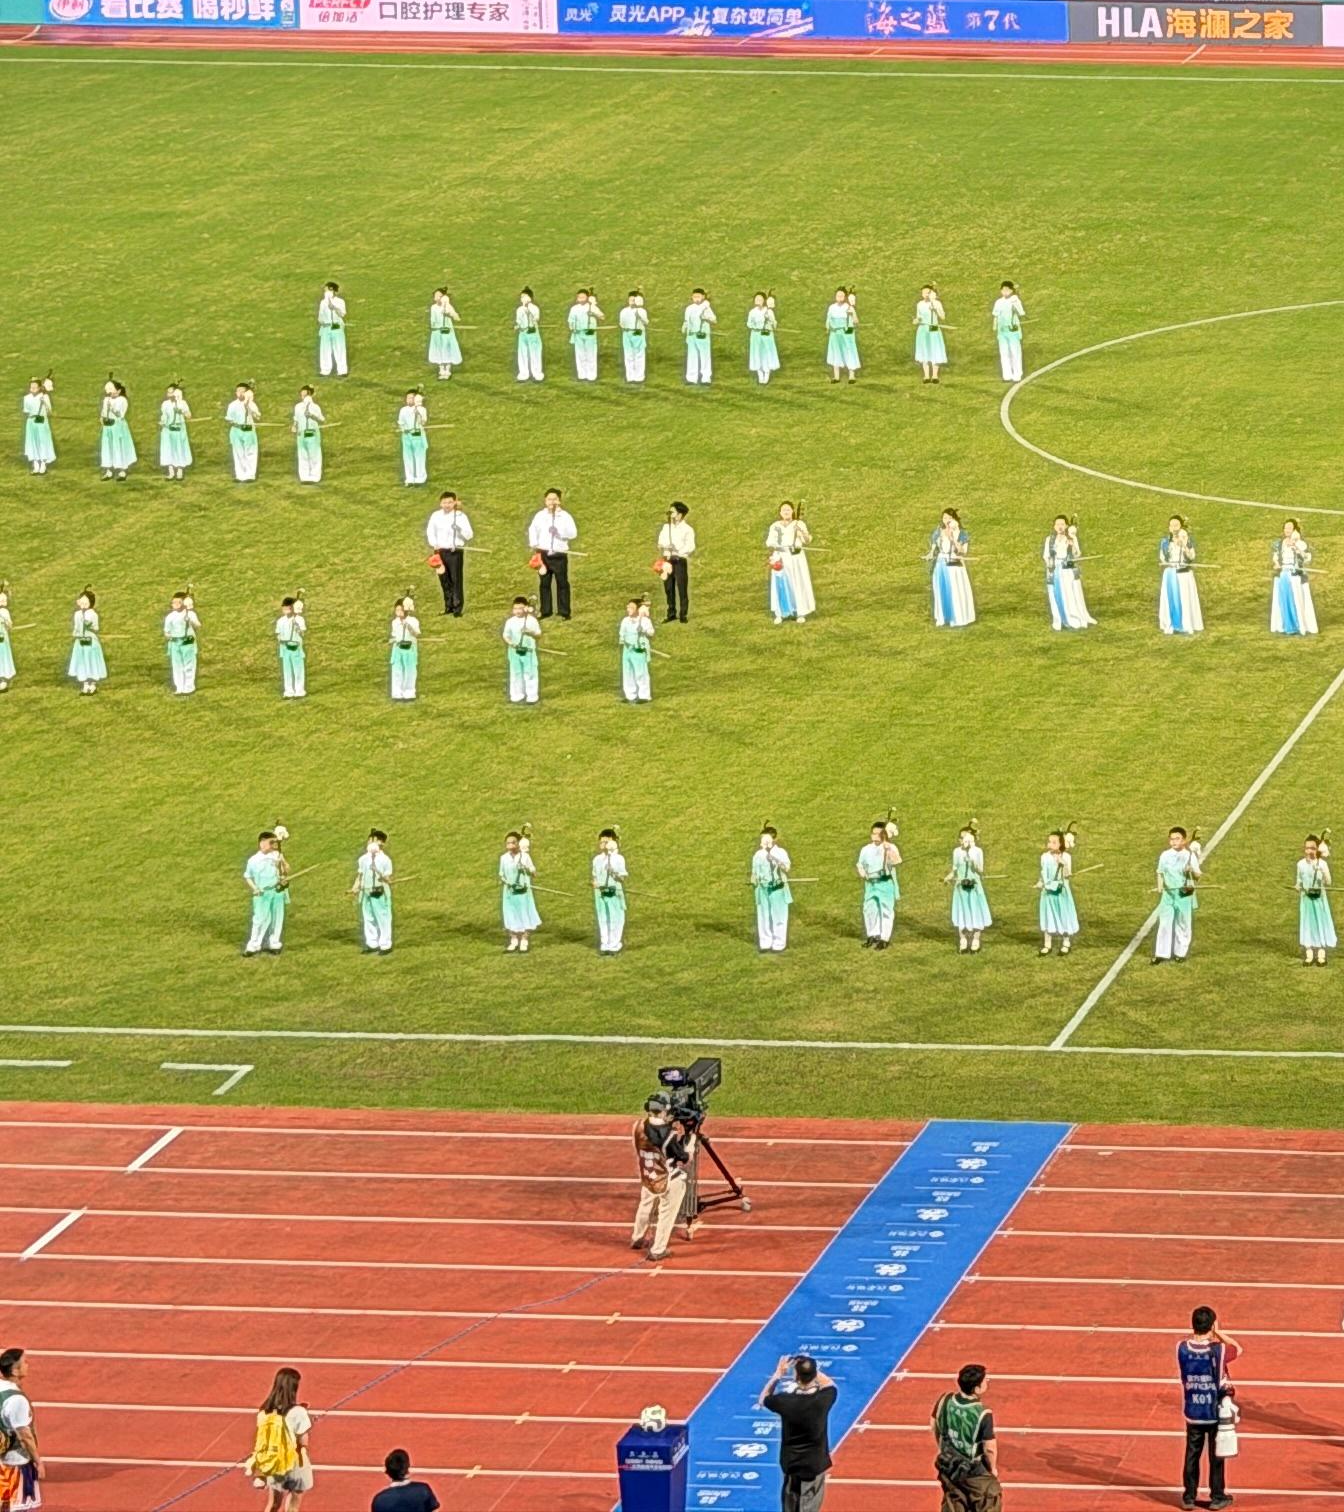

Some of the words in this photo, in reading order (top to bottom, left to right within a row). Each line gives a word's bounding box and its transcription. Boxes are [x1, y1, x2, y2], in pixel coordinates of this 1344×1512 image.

[379, 1, 510, 22] 口腔护理专家
[609, 6, 685, 23] 灵光APP
